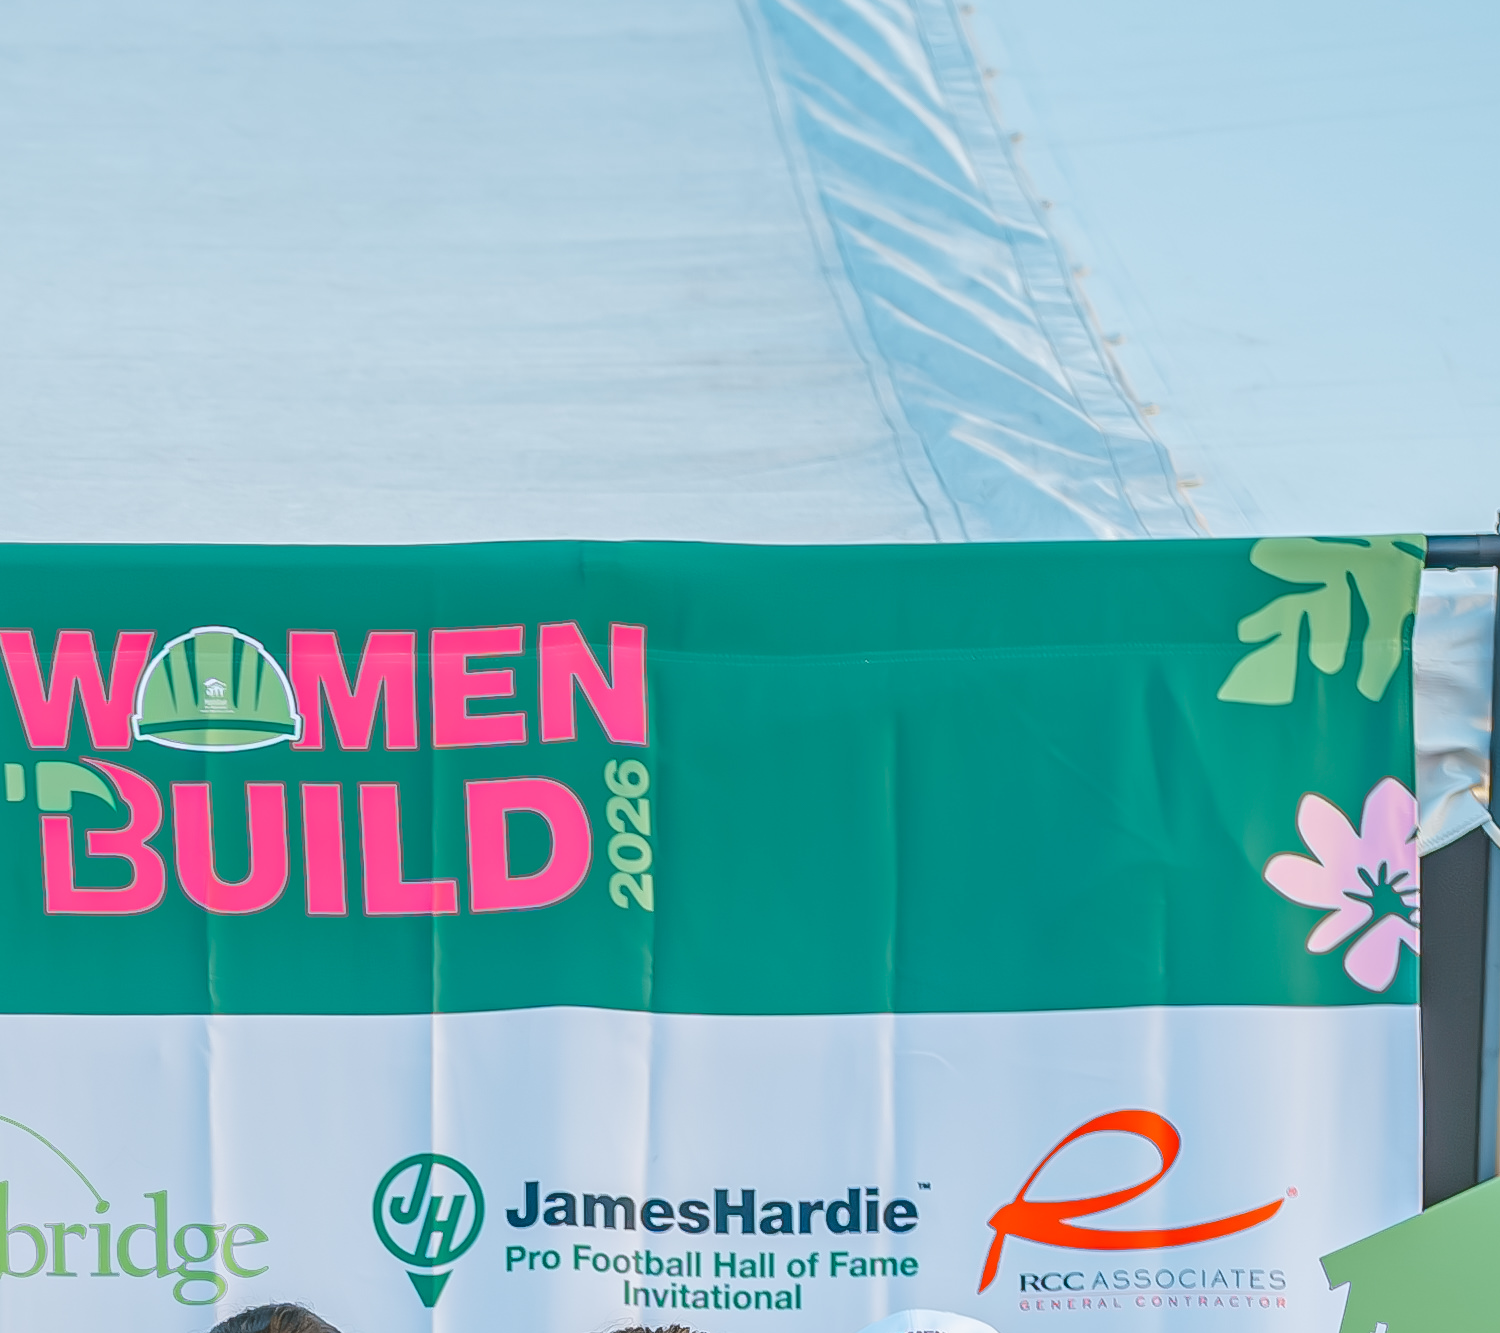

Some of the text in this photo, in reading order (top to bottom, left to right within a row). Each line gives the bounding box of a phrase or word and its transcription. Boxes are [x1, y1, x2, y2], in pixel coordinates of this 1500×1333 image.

[38, 756, 593, 915] BUILD
[603, 757, 655, 913] 2026
[505, 1245, 919, 1279] Pro Football Hall of Fame
[624, 1280, 803, 1311] Invitational
[1019, 1268, 1287, 1294] RCC ASSOCIATES
[1019, 1295, 1287, 1312] GENERAL CONTRACTOR
